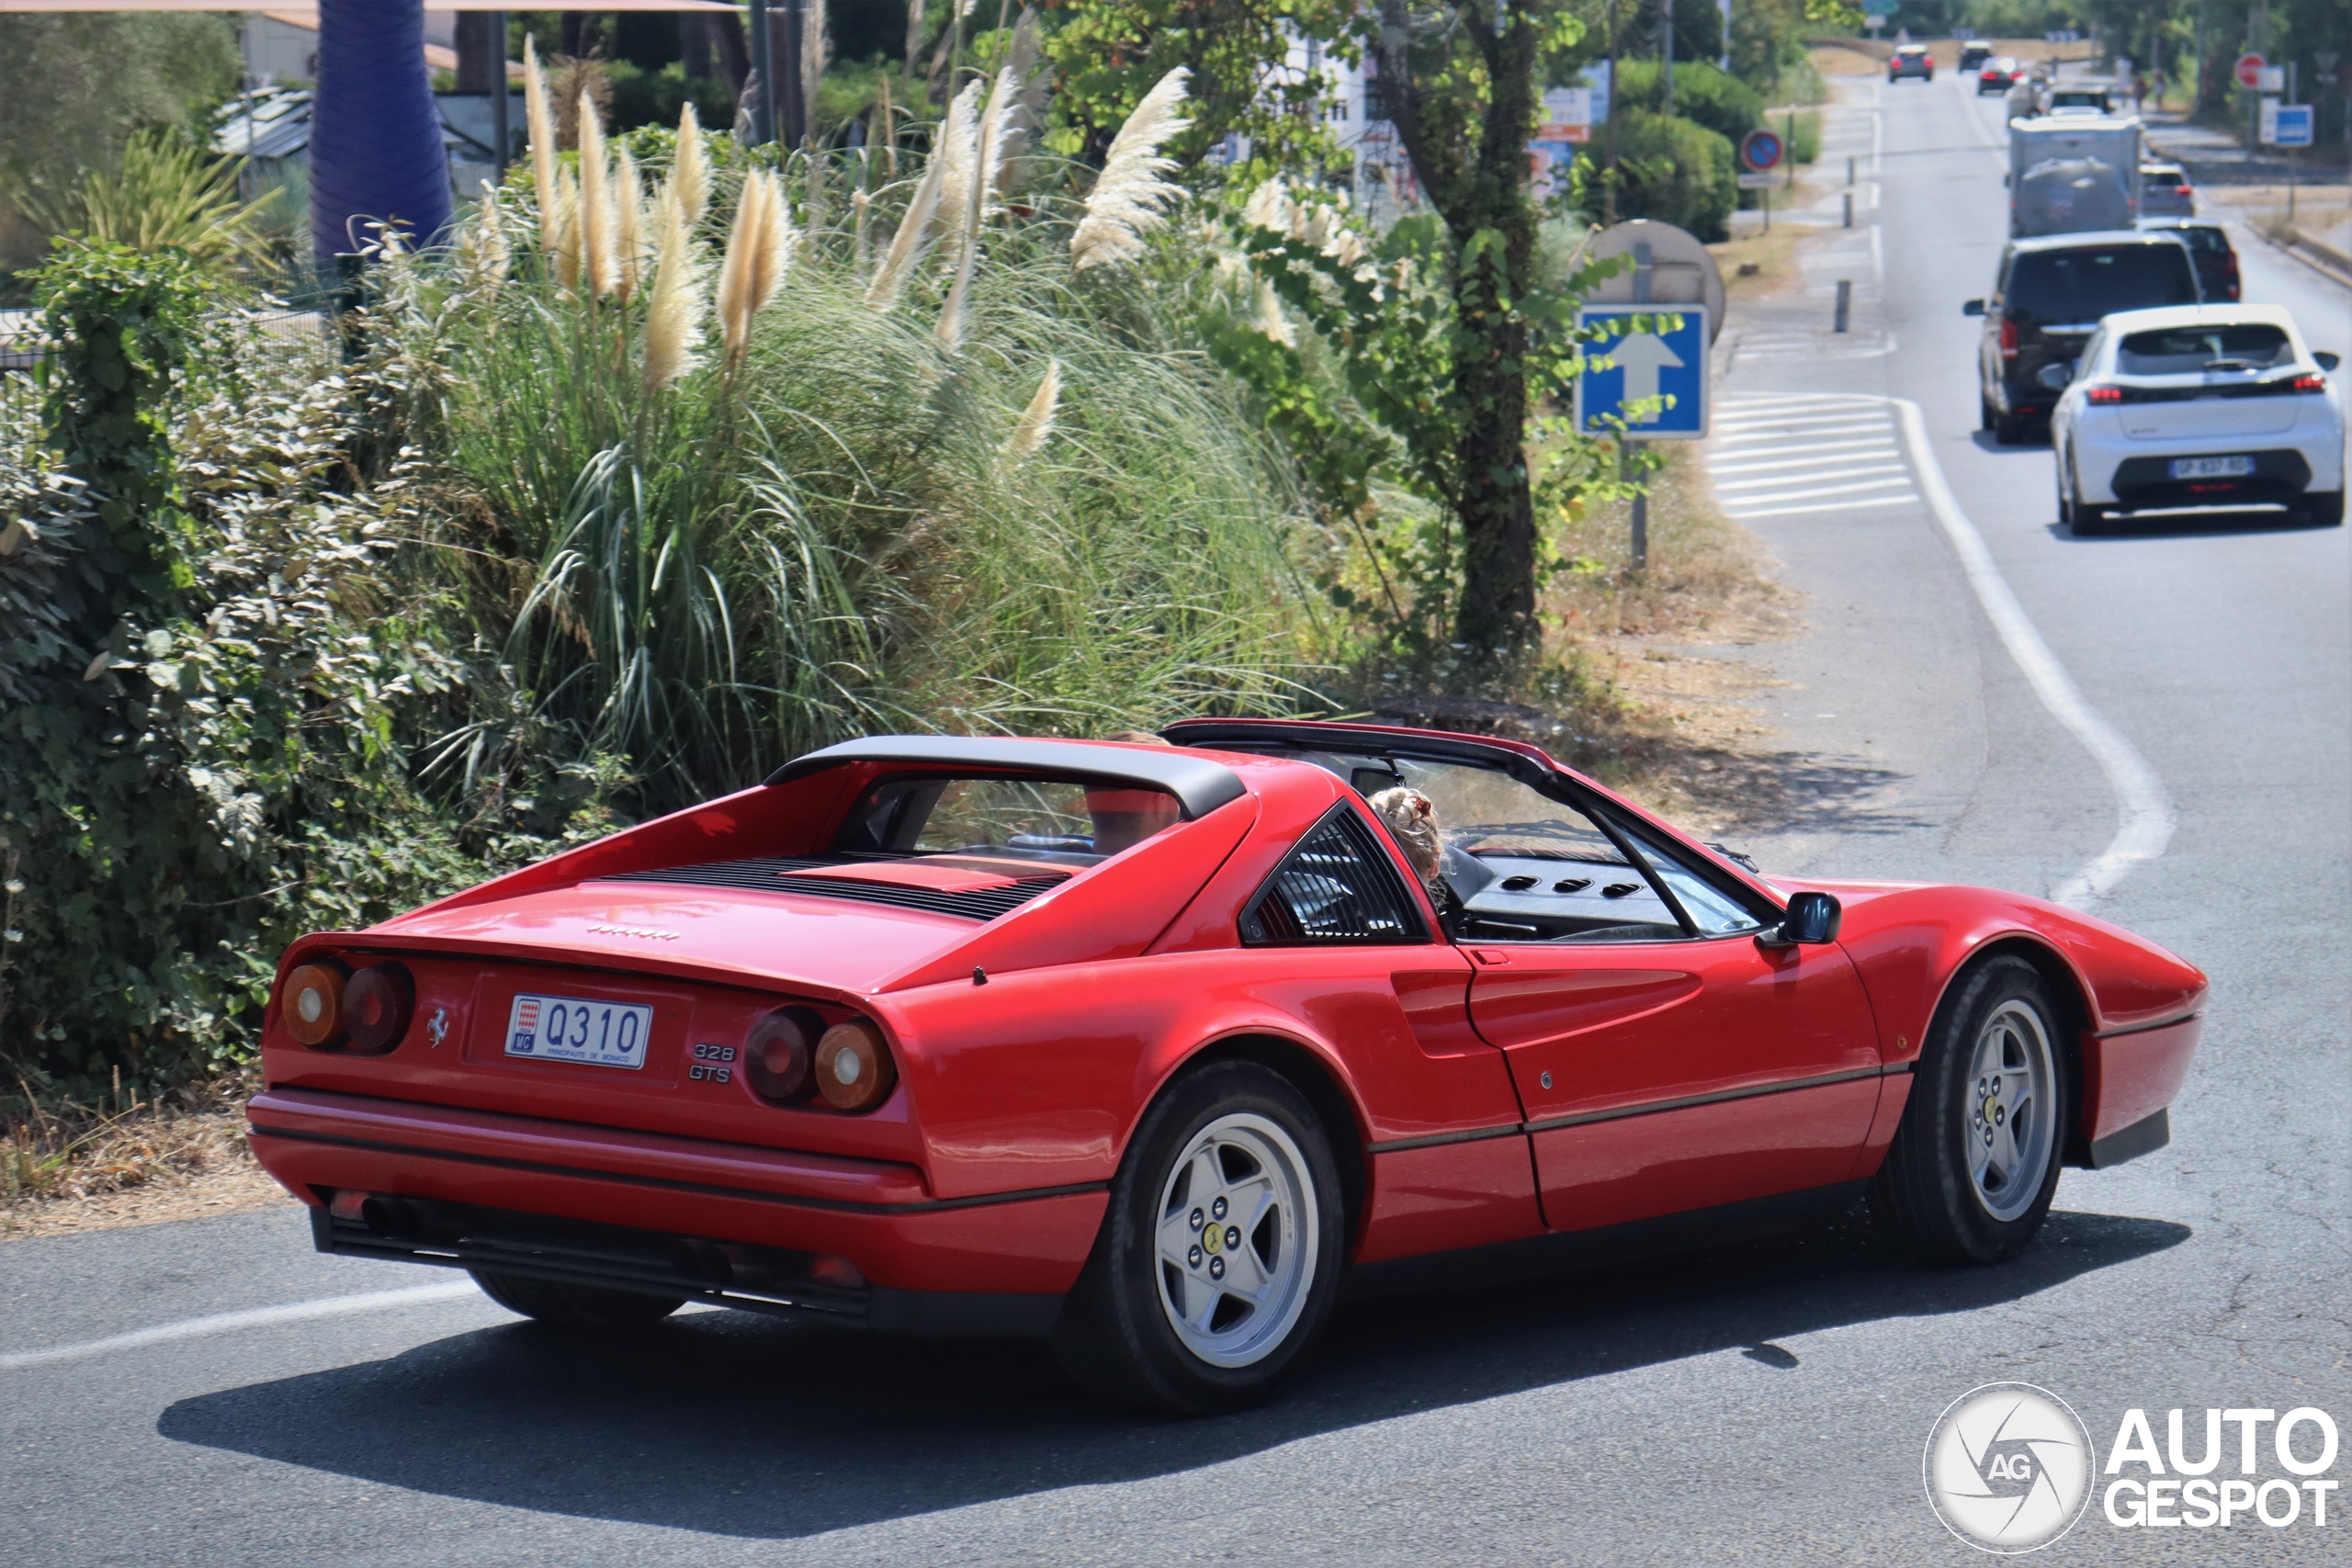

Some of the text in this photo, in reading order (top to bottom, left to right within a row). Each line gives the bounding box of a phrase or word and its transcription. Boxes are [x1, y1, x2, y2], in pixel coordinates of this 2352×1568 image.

[546, 1004, 639, 1054] Q310
[515, 1035, 530, 1049] MC
[602, 1054, 629, 1063] MONACO
[694, 1043, 735, 1061] 328
[689, 1065, 730, 1083] GTS
